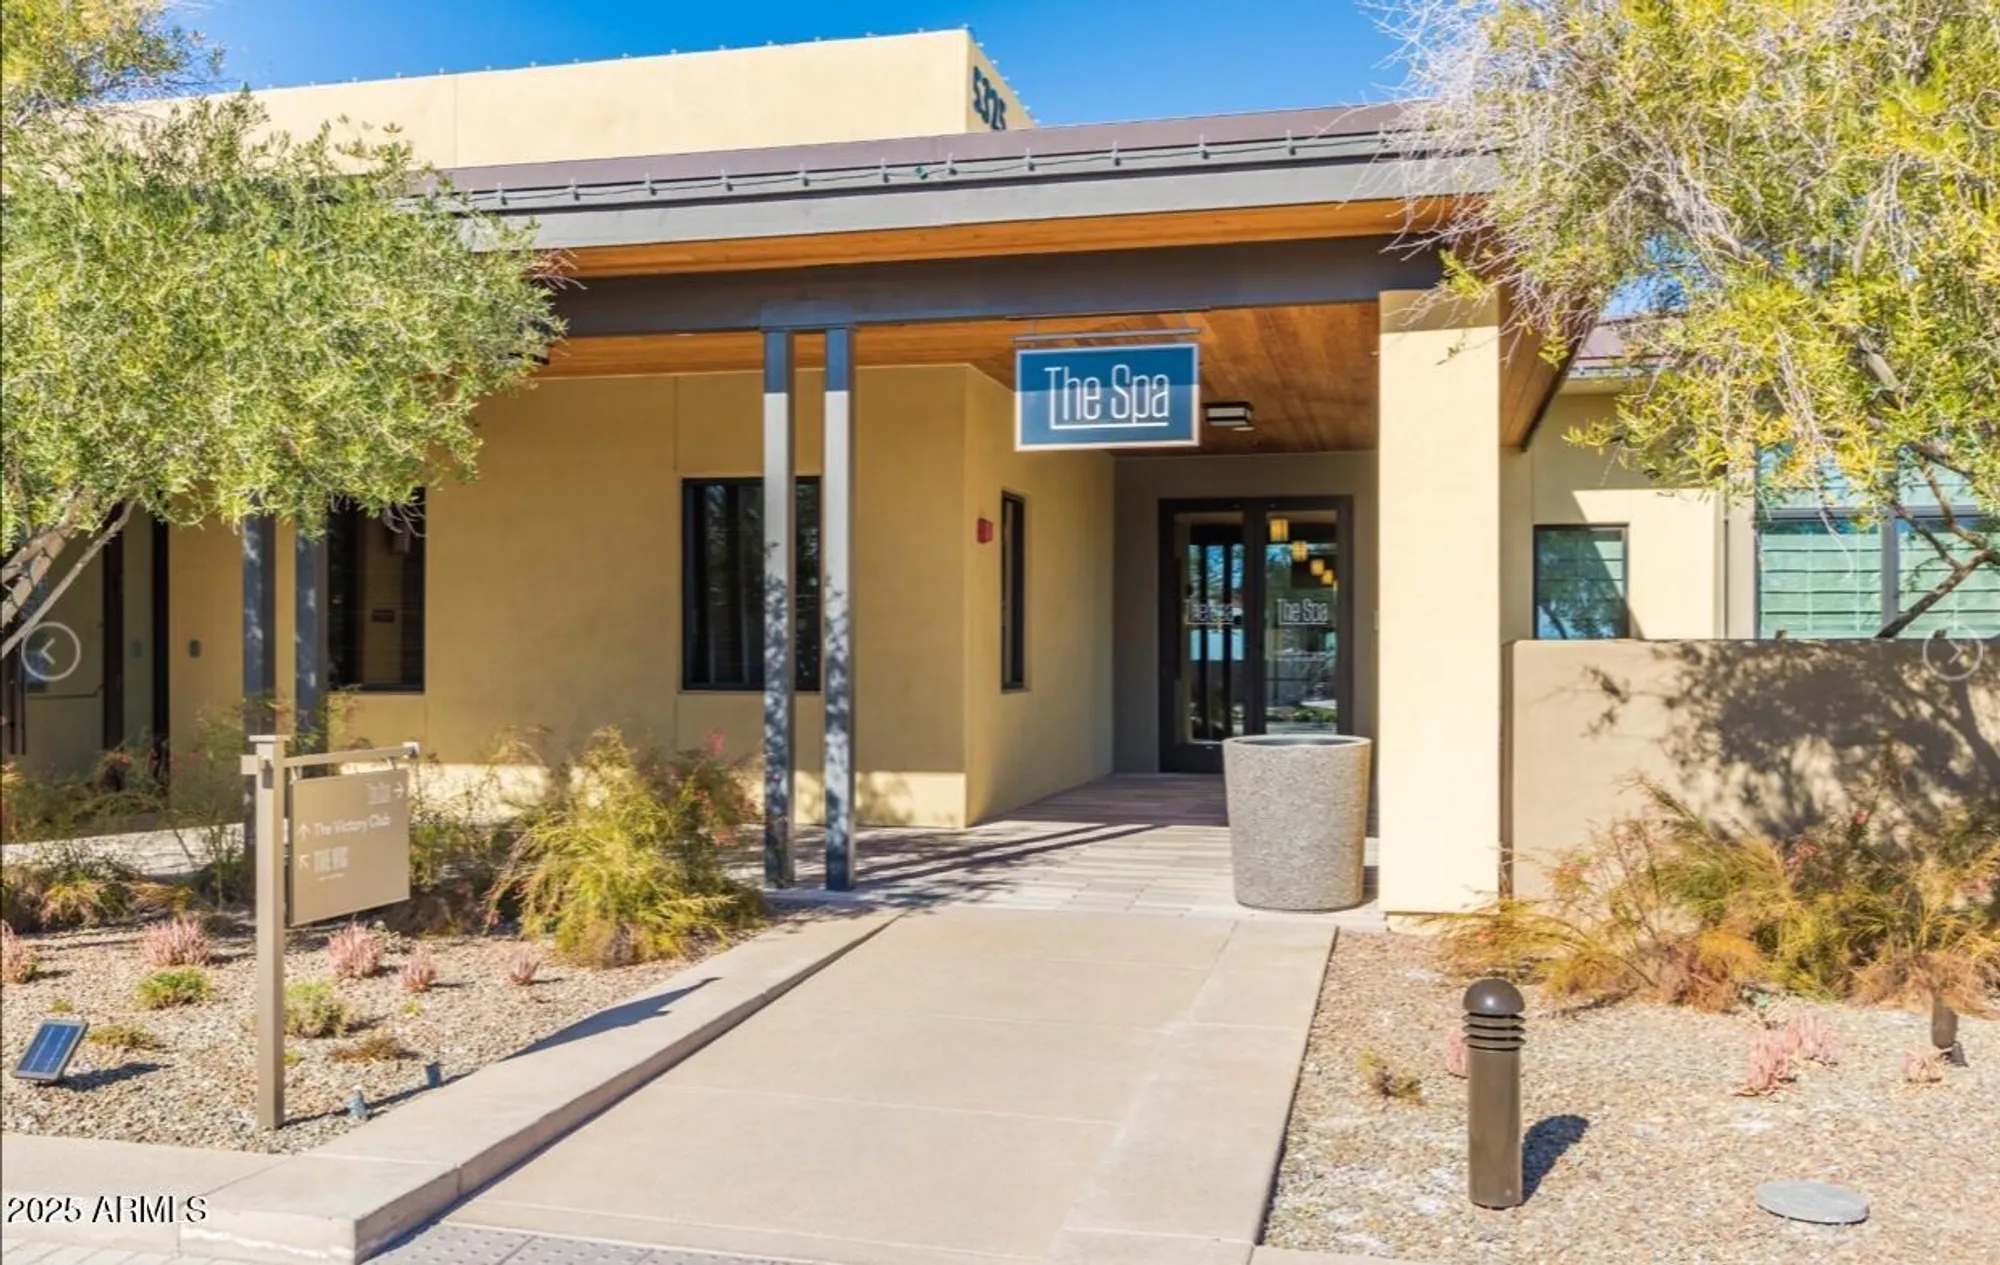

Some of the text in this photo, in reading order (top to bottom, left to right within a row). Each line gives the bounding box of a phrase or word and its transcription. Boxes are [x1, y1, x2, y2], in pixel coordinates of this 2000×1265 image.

[1044, 364, 1170, 429] The Spa
[1277, 598, 1328, 624] The Spa
[314, 812, 392, 836] The Victory Club
